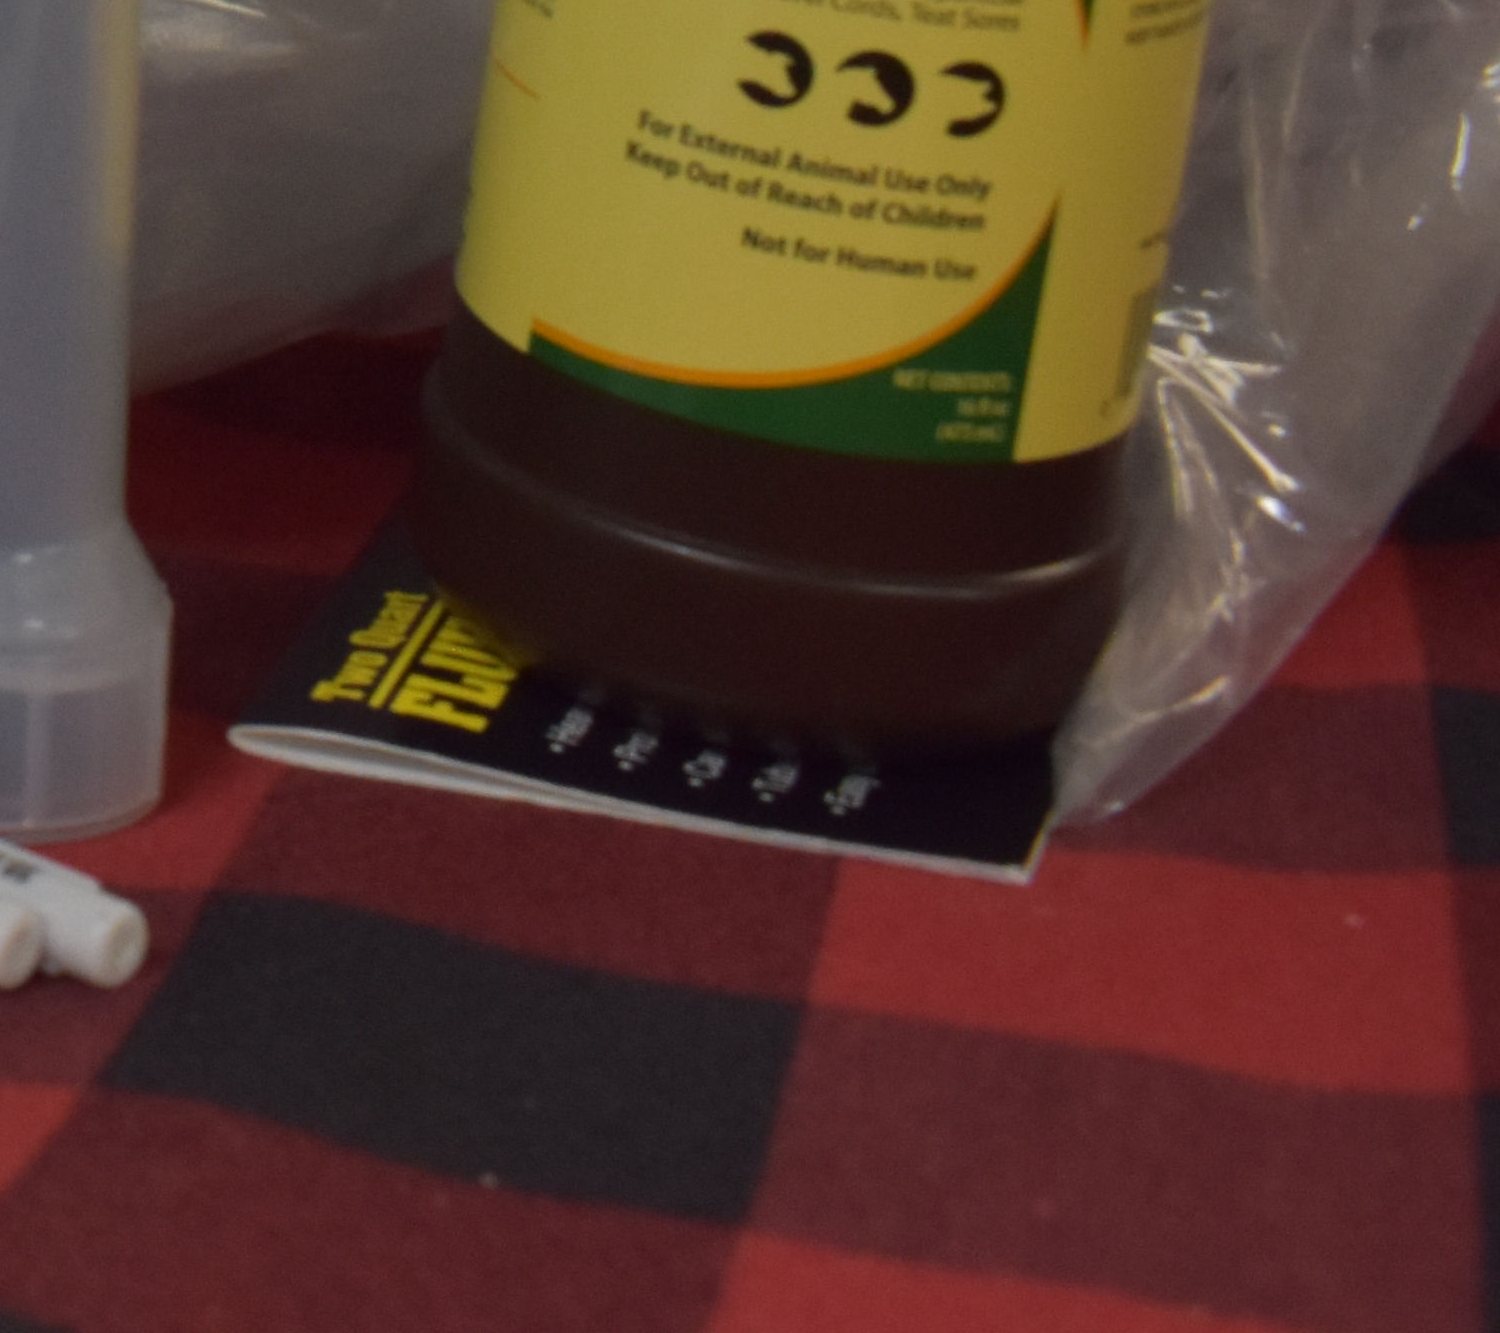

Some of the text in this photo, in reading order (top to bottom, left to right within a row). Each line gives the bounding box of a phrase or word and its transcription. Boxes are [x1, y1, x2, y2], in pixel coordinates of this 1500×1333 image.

[625, 139, 986, 231] Keep Out of Reach of Children
[639, 109, 992, 203] For External Animal Use Only
[741, 225, 977, 281] Not for Human Use
